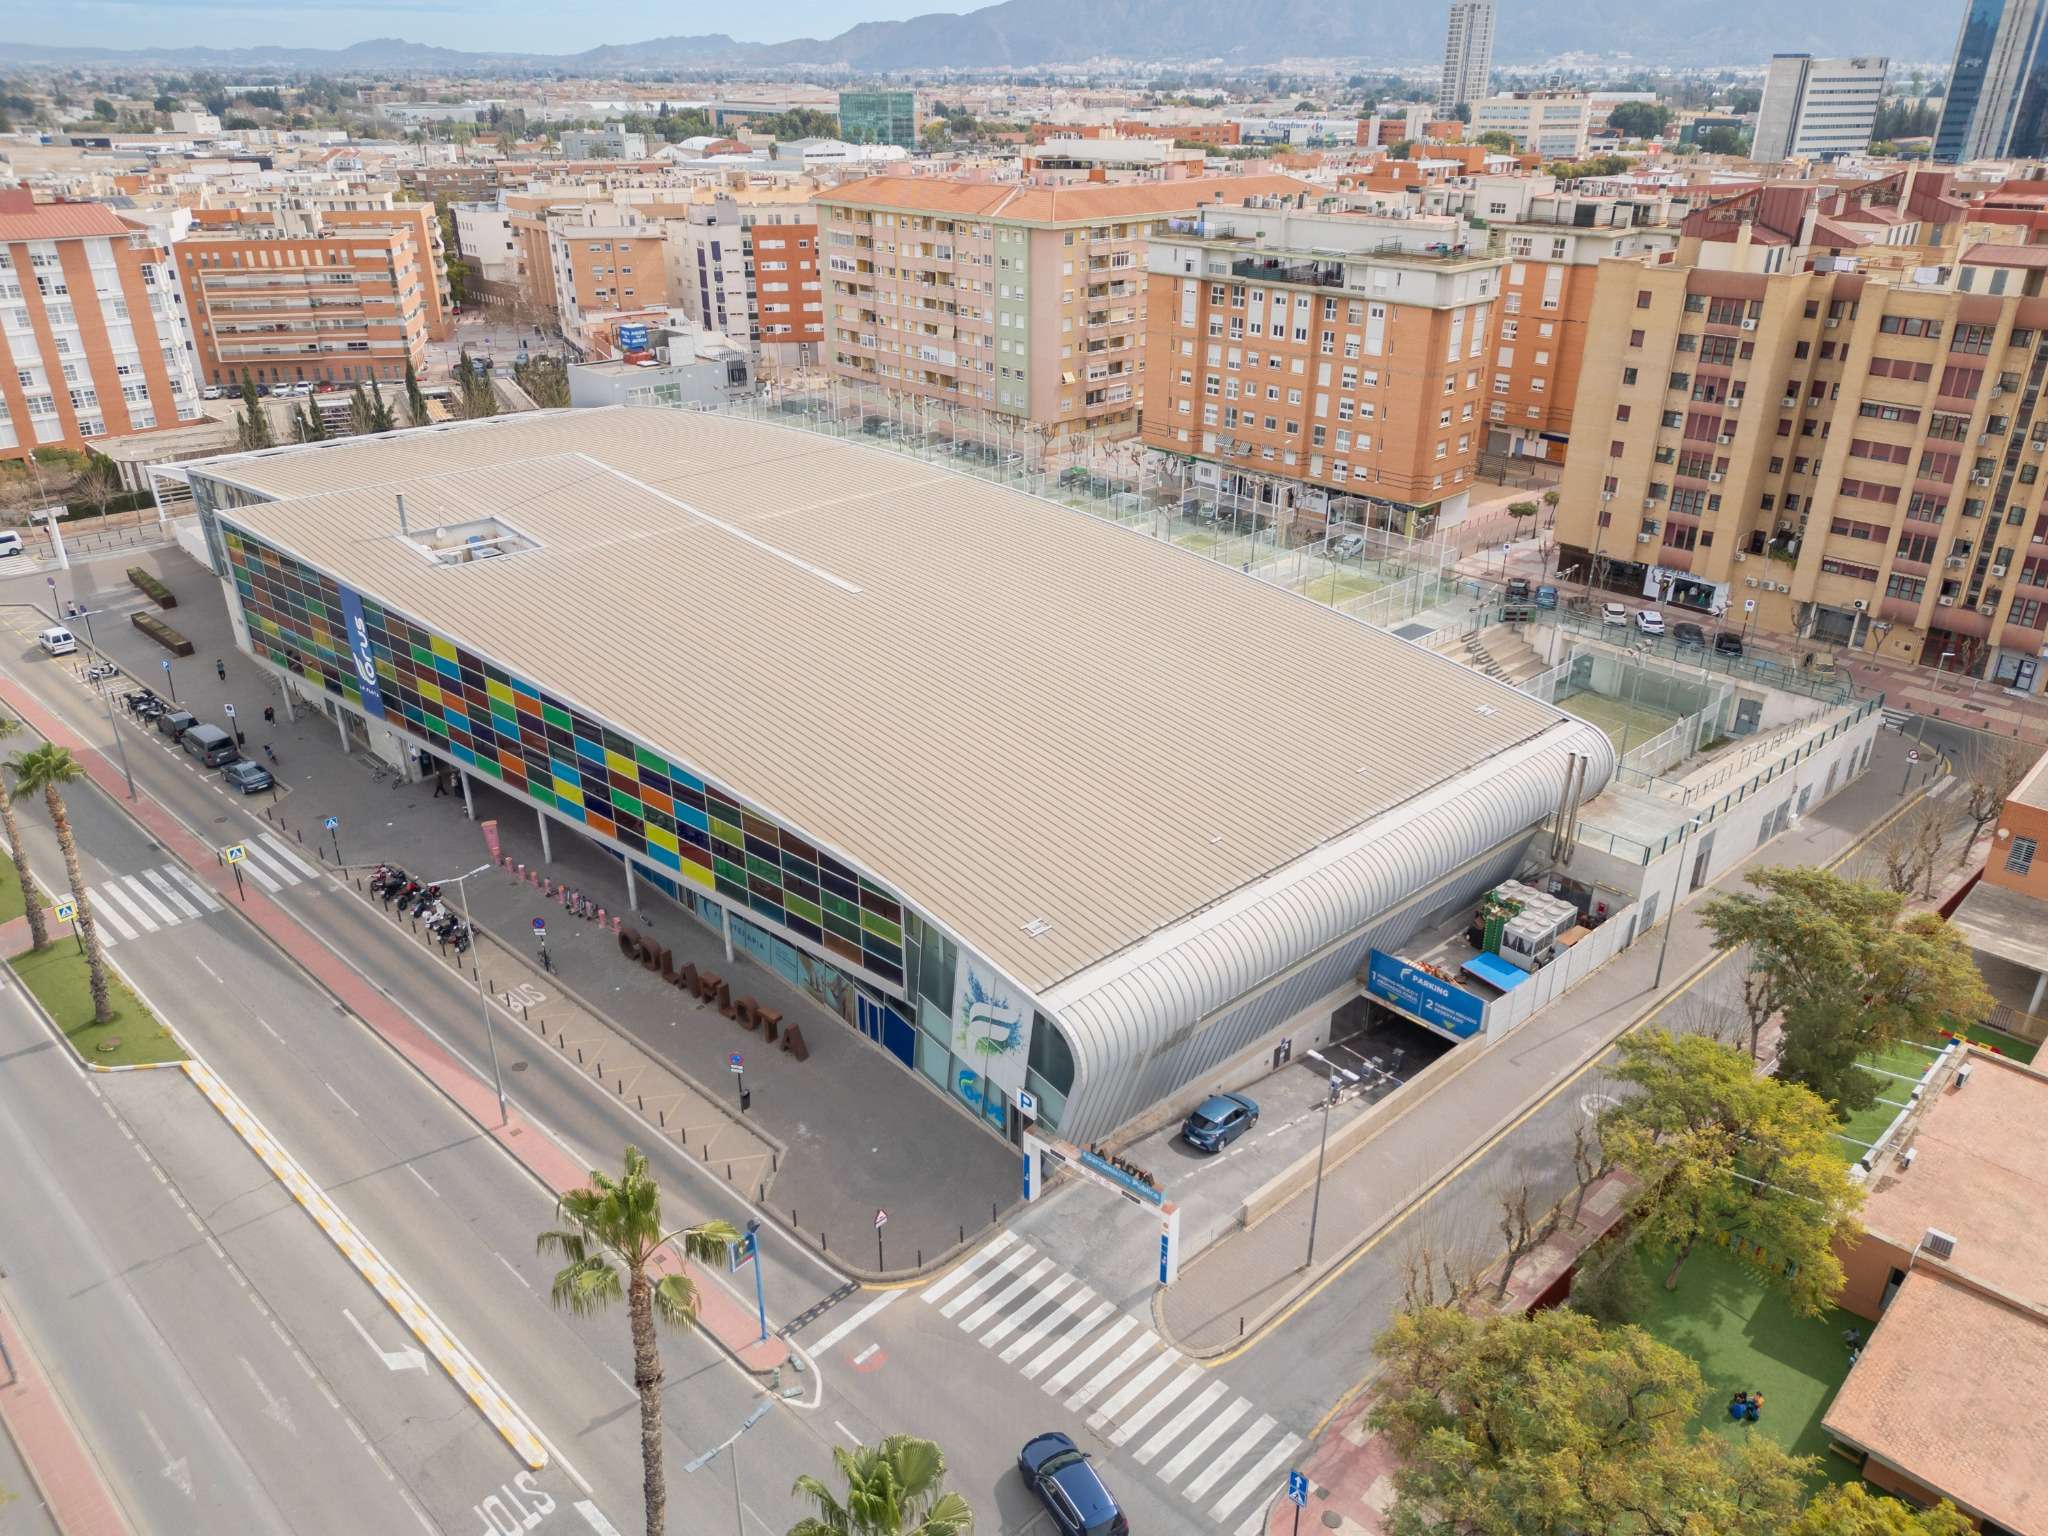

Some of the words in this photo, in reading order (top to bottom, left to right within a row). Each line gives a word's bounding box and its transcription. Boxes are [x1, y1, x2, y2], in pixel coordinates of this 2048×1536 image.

[1412, 974, 1449, 998] PARKING
[1425, 999, 1434, 1010] 2
[1020, 1092, 1033, 1109] P
